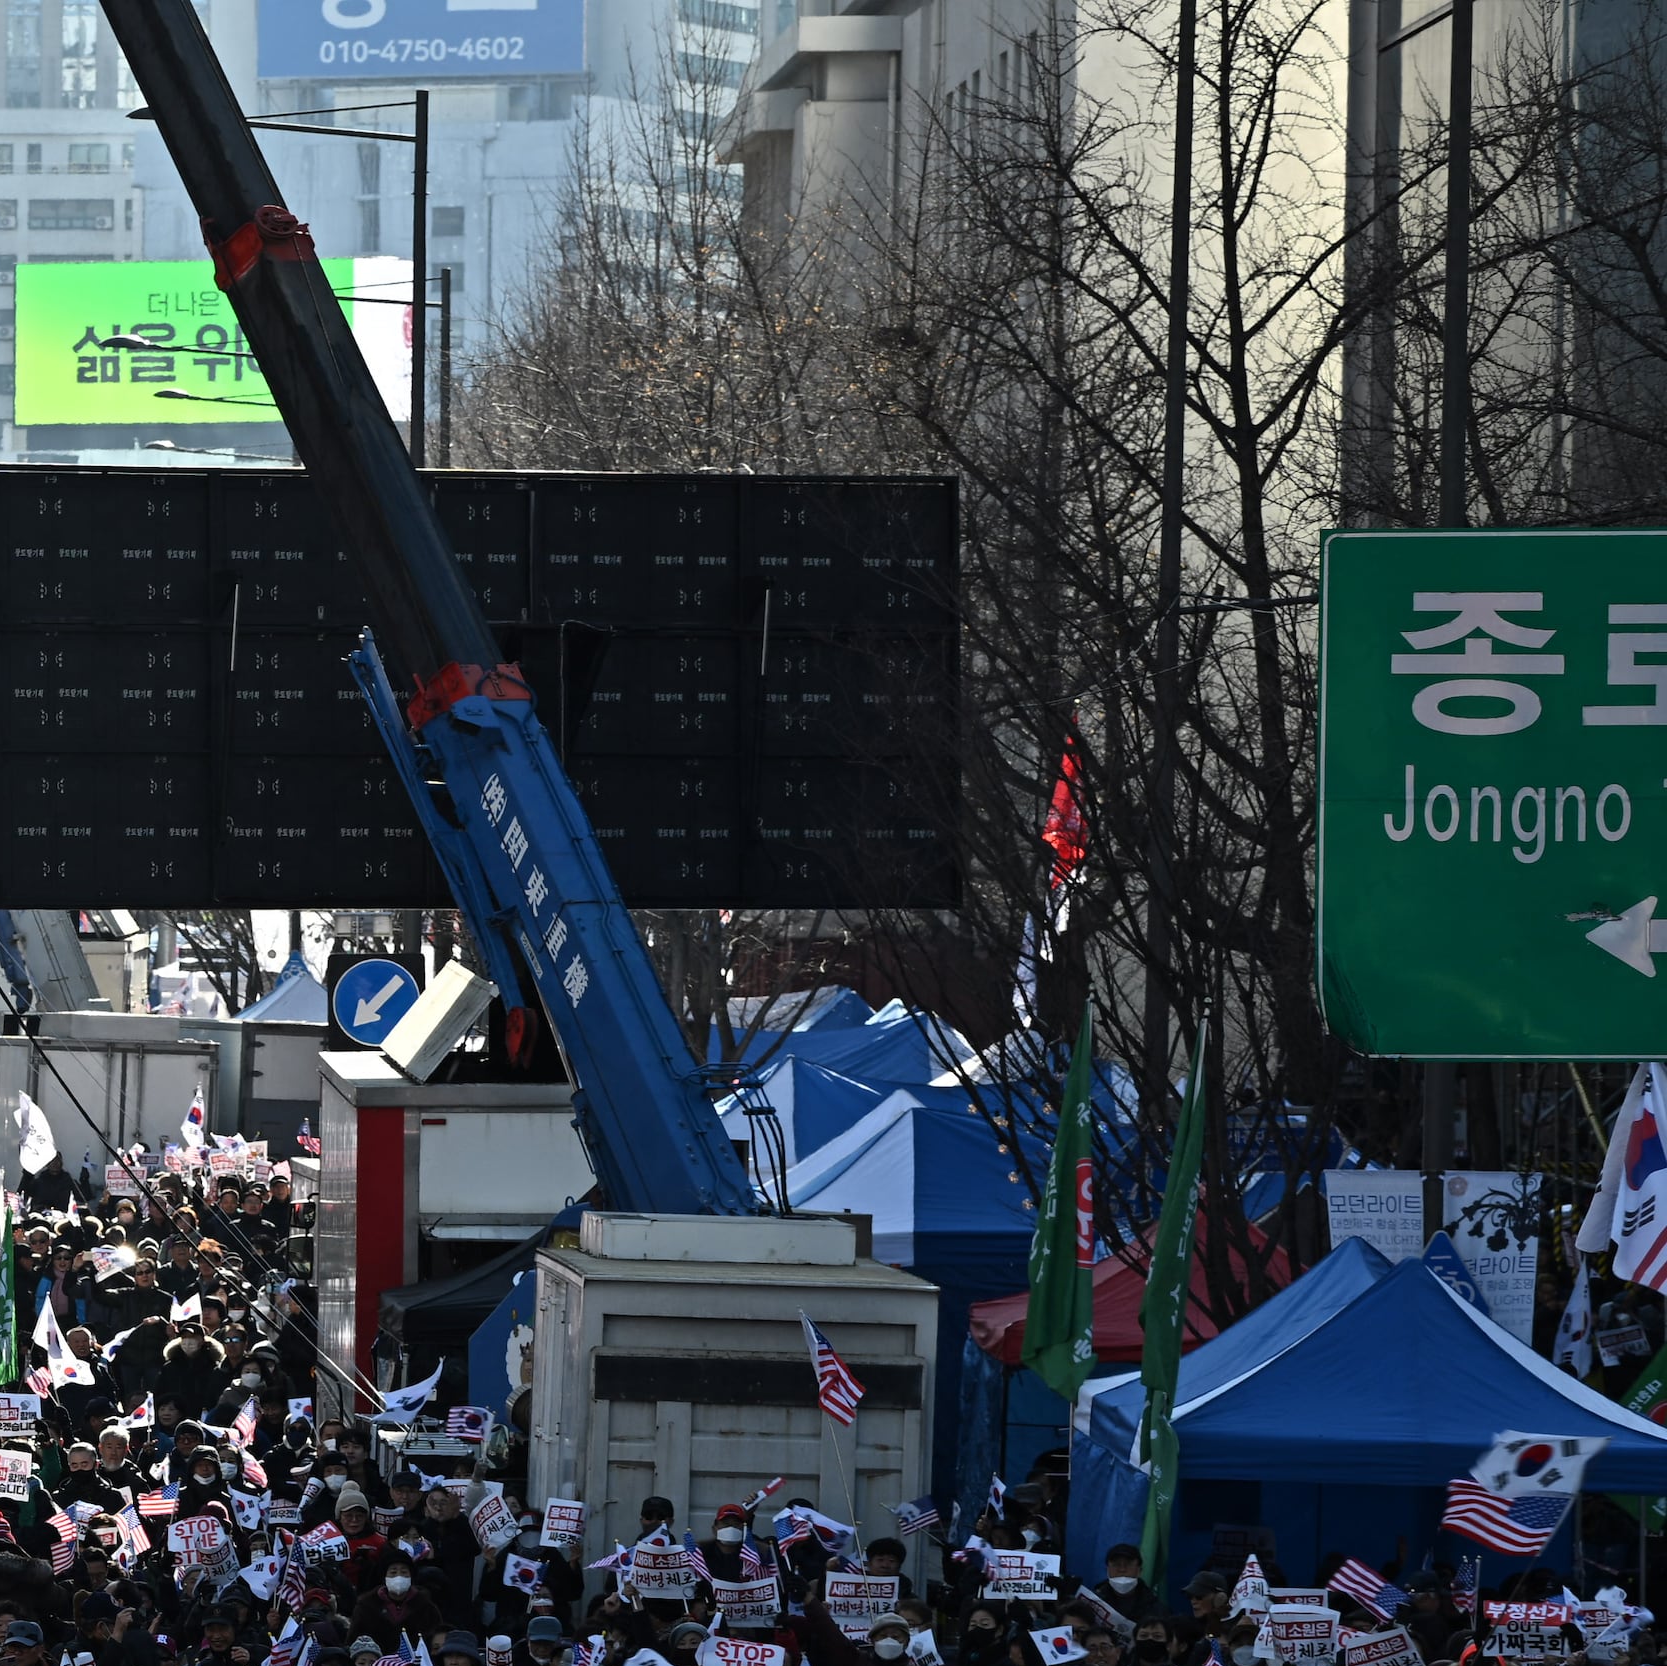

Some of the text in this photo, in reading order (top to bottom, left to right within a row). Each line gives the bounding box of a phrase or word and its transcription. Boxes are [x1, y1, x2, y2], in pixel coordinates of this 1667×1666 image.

[319, 37, 525, 64] 010-4750-4602
[148, 291, 220, 317] 더 나은
[72, 323, 262, 384] 삶을 위
[1383, 764, 1632, 864] Jongno
[1330, 1195, 1421, 1214] 모던라이트
[1464, 1257, 1535, 1275] 던라이트
[716, 1584, 774, 1604] 새해 소원은
[832, 1583, 893, 1597] 새해 소원은
[991, 1582, 1054, 1594] 싸우겠습니다
[1486, 1602, 1567, 1621] 부정선거
[1289, 1622, 1331, 1638] 소원은
[1507, 1621, 1542, 1633] OUT
[715, 1641, 775, 1661] STOP
[1348, 1637, 1407, 1665] 새해 소원은
[1488, 1634, 1565, 1654] 가짜국회
